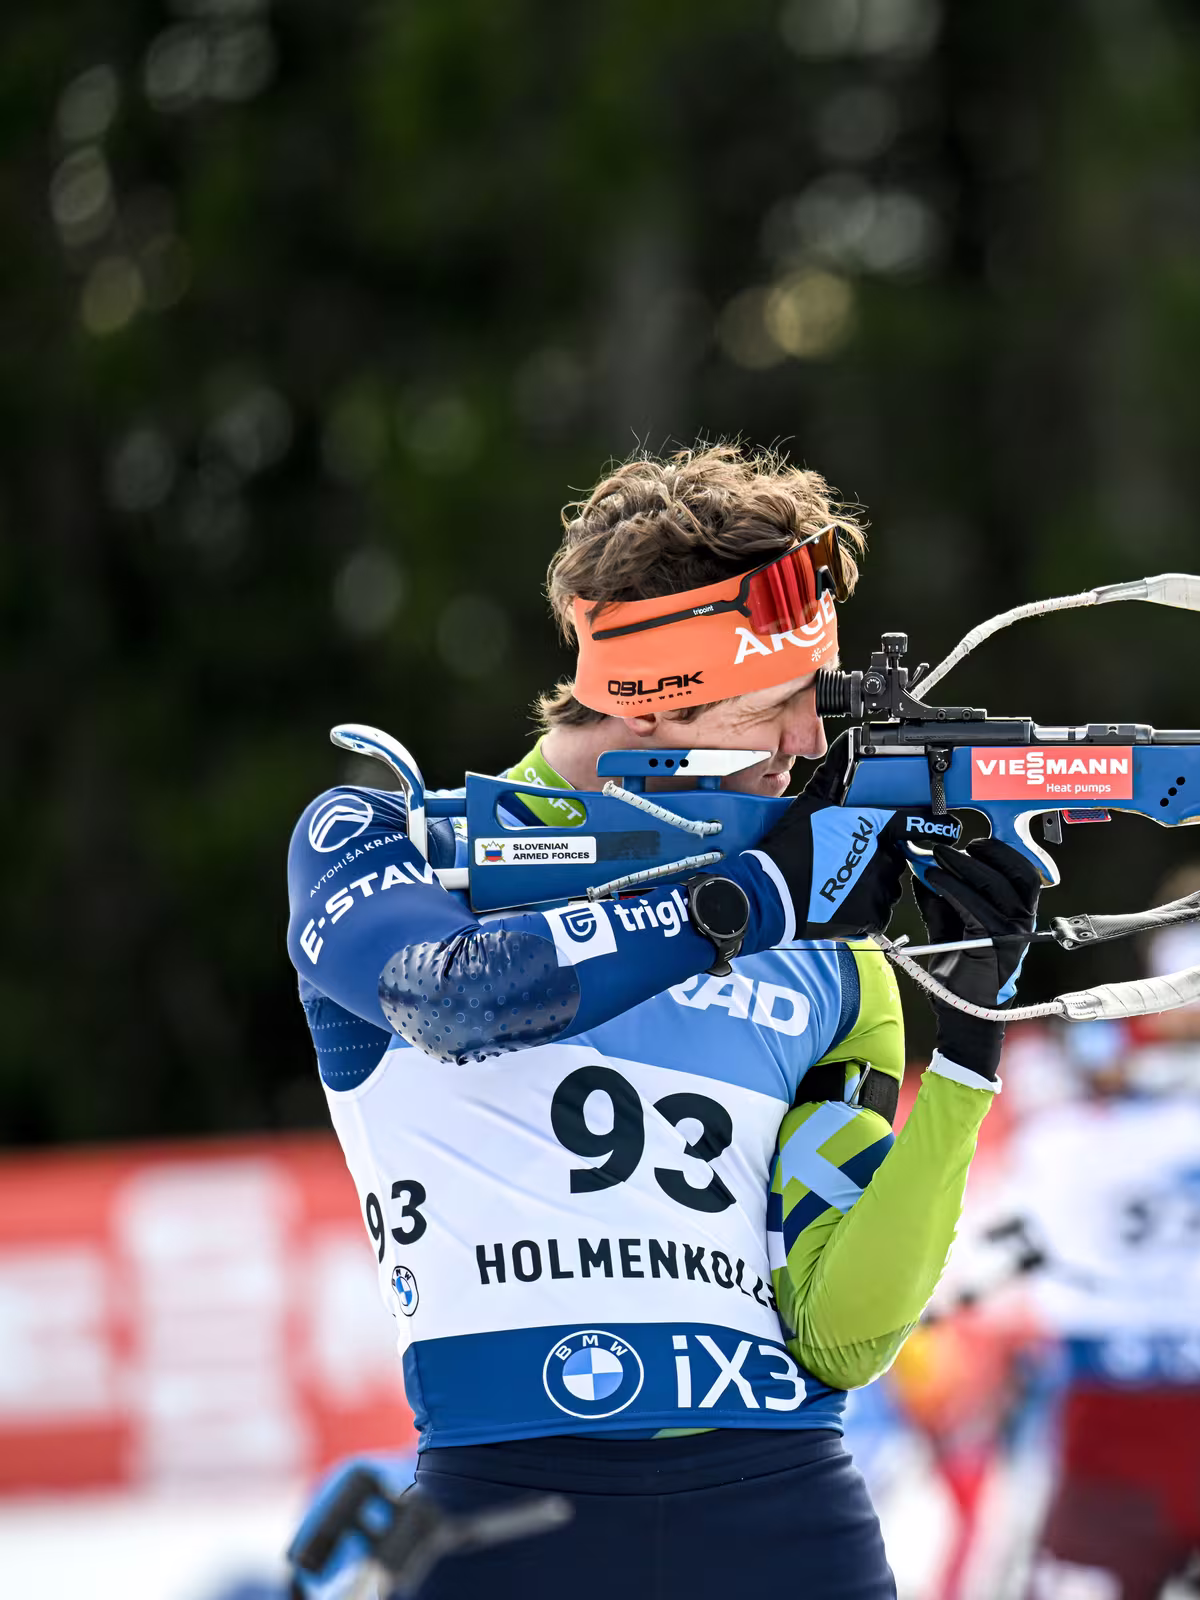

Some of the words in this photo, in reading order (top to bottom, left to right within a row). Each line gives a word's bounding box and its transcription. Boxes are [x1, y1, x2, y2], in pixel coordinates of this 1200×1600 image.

[608, 671, 704, 697] OBLAK
[976, 752, 1129, 785] VIESSMANN
[1046, 783, 1072, 793] Heat
[1075, 784, 1112, 795] pumps
[364, 833, 408, 851] KRAN
[513, 843, 568, 851] SLOVENIAN
[513, 852, 549, 860] ARMED
[552, 852, 590, 860] FORCES
[613, 888, 689, 938] trigl
[550, 1065, 737, 1213] 93
[366, 1180, 427, 1264] 93
[556, 1334, 629, 1361] BMW
[673, 1335, 807, 1411] iX3
